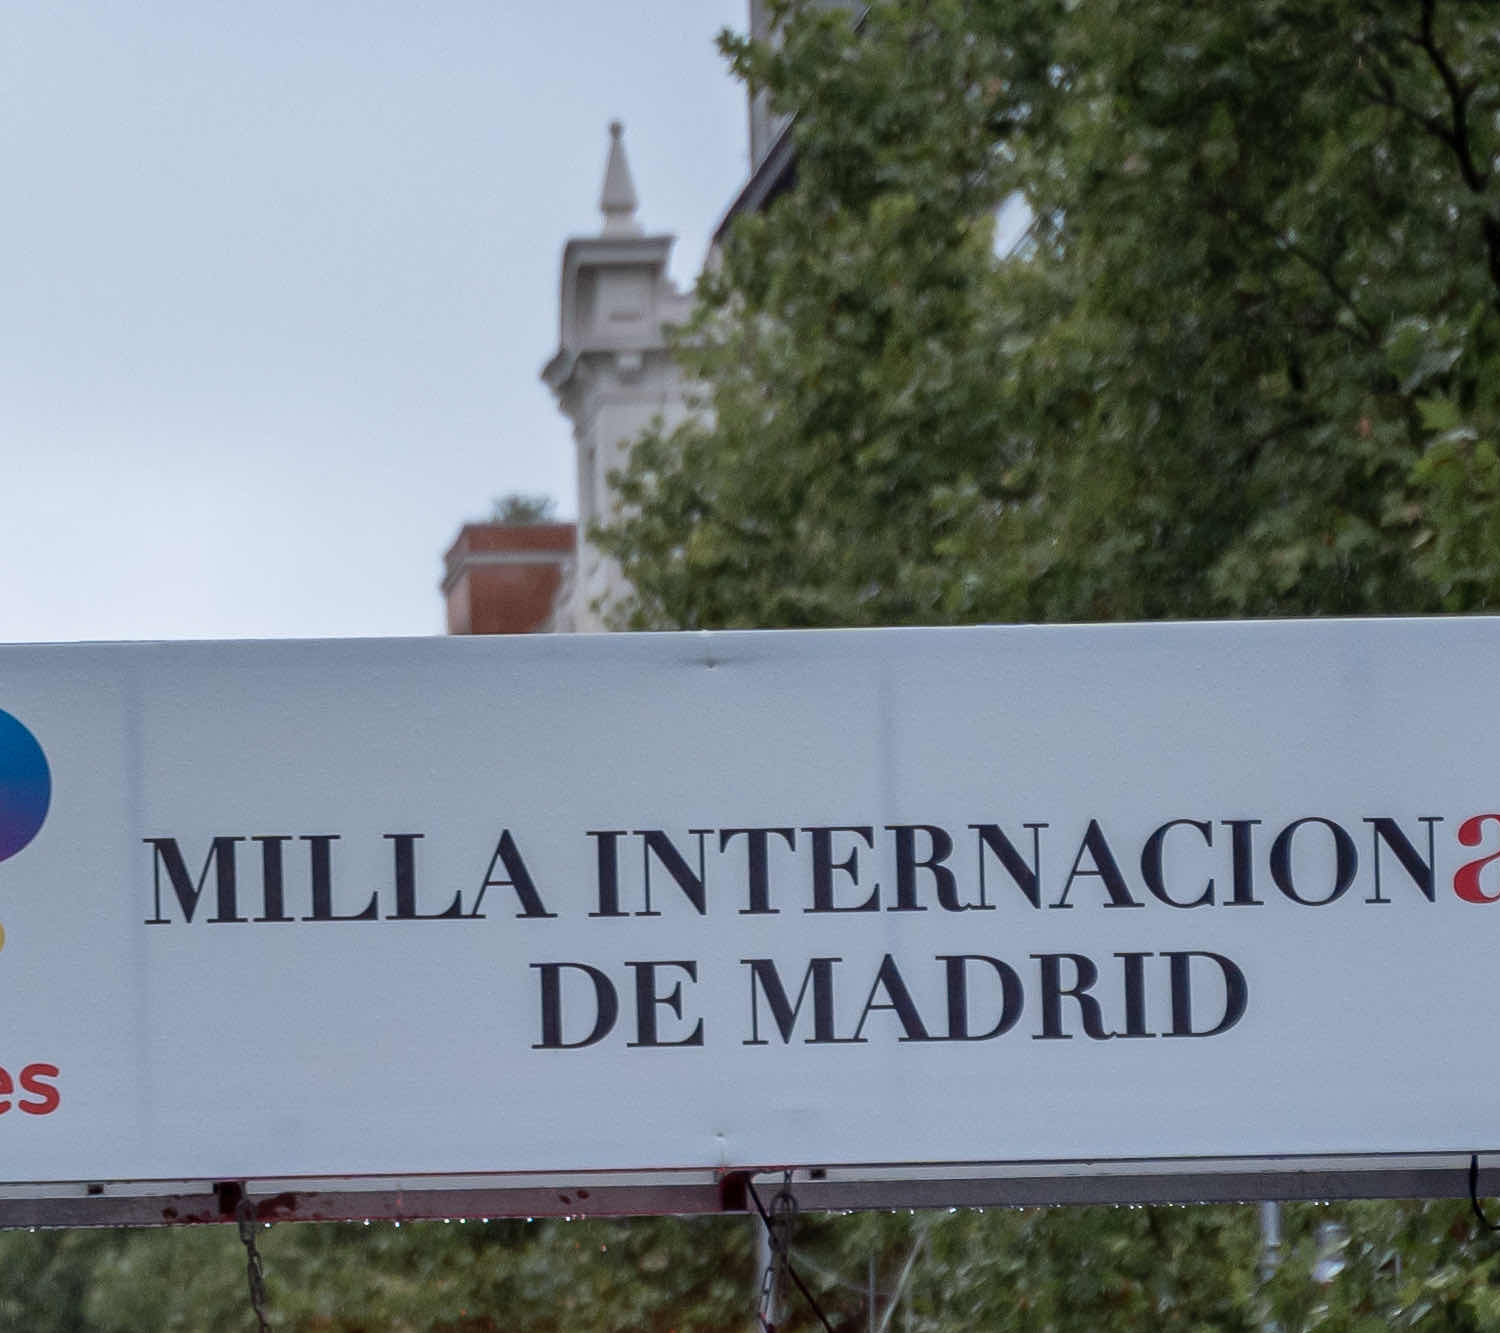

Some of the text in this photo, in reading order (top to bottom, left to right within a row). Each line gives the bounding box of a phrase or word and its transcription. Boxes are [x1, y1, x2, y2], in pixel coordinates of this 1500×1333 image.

[143, 830, 557, 924] MILLA
[530, 951, 1247, 1049] DE MADRID
